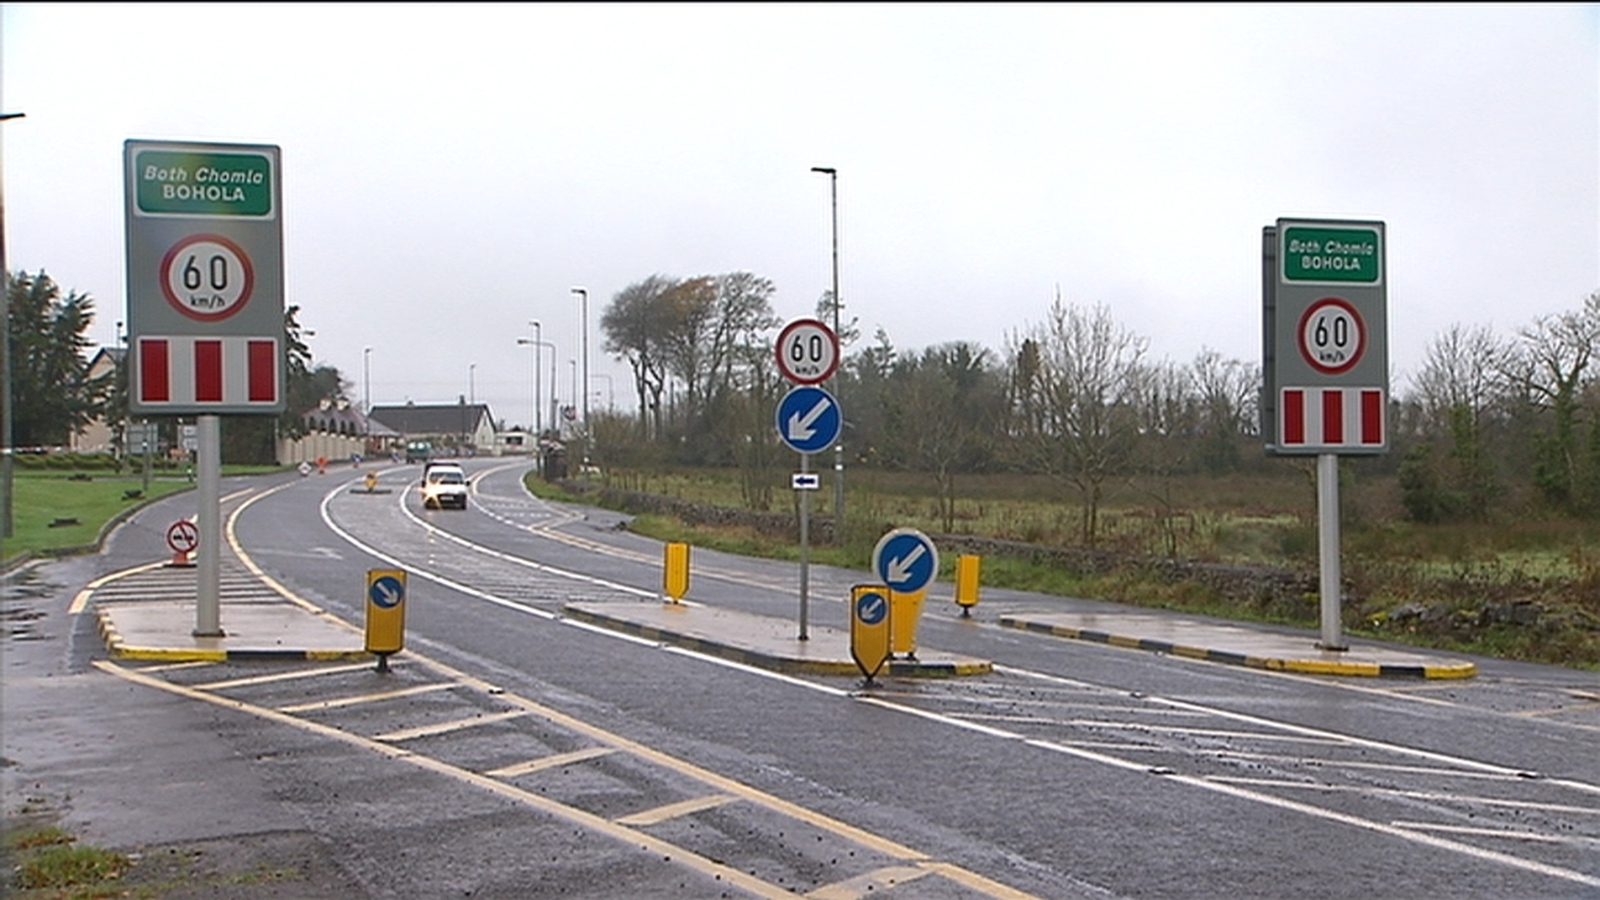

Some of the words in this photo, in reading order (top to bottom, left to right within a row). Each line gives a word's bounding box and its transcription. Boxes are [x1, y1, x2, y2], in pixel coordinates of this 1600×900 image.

[144, 165, 187, 181] Both
[195, 167, 263, 183] Chomla
[163, 184, 245, 201] BOHOLA
[1302, 256, 1360, 270] BOHOLA
[183, 255, 228, 291] 60
[190, 295, 226, 309] km/h
[1315, 316, 1347, 347] 60
[791, 335, 822, 362] 60
[1319, 351, 1345, 362] km/h
